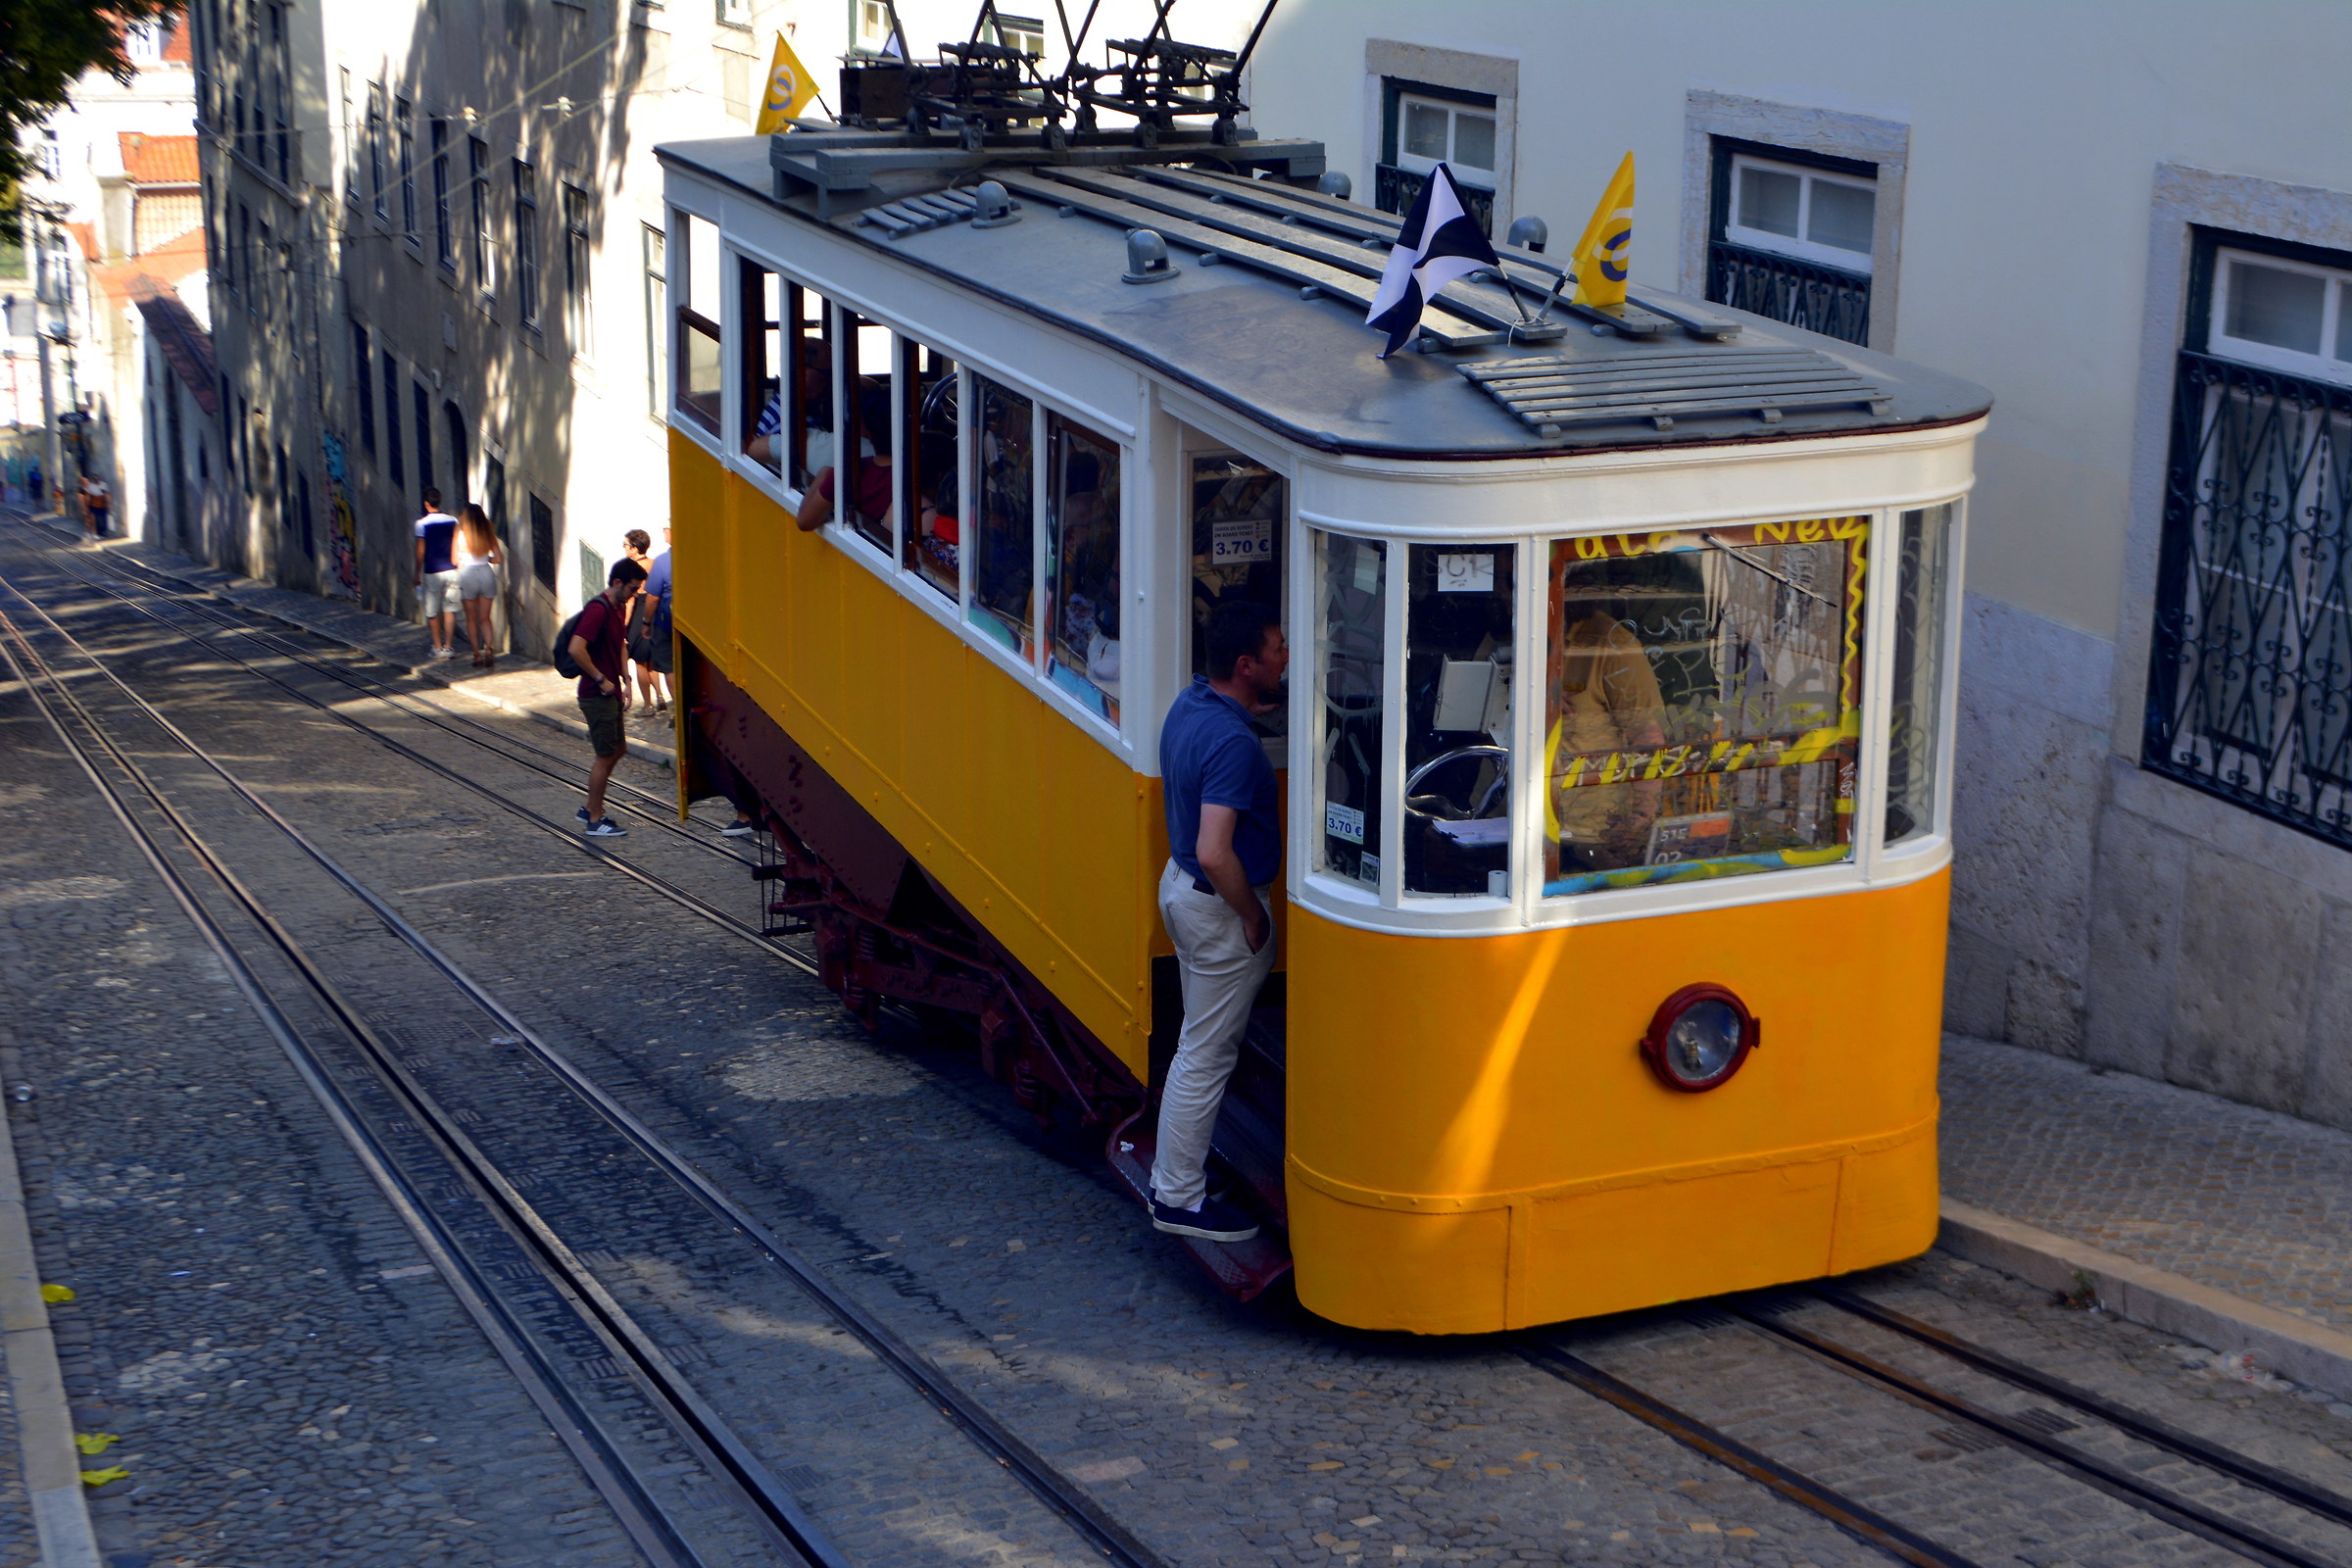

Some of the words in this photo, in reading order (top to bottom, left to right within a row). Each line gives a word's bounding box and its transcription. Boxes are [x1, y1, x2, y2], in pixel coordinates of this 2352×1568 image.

[1215, 540, 1252, 555] 3.70
[1258, 538, 1269, 552] €
[1328, 817, 1351, 834] 3.70
[1354, 826, 1362, 837] €
